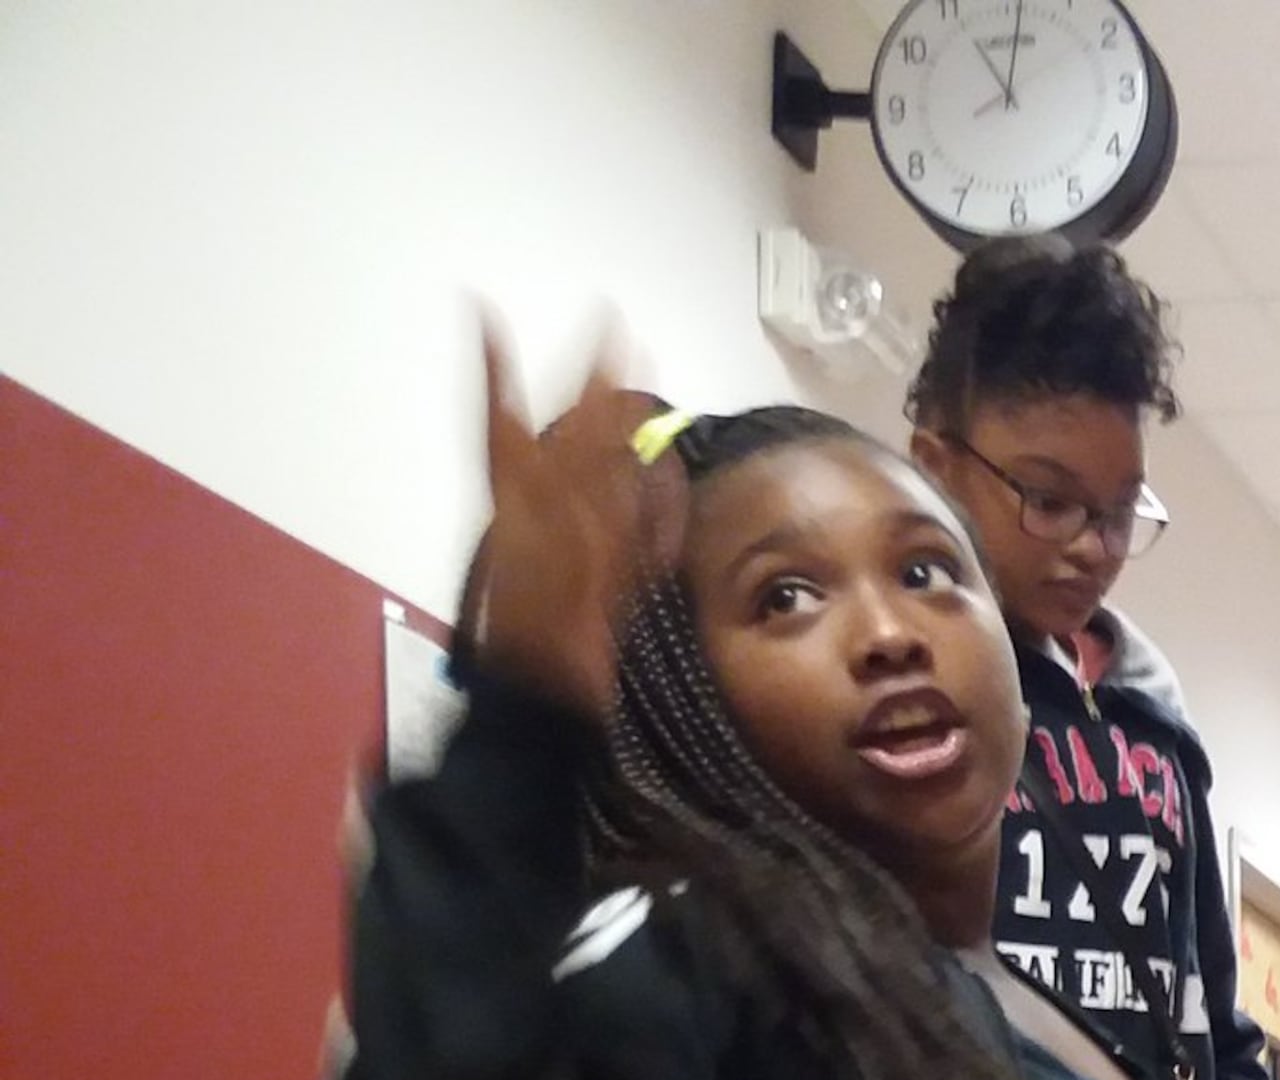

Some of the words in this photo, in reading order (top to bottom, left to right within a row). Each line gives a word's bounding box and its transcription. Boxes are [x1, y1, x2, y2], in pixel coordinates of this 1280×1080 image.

[1101, 17, 1117, 49] 2
[902, 35, 927, 65] 10
[1118, 72, 1135, 103] 3
[888, 95, 905, 125] 9
[1105, 132, 1121, 159] 4
[908, 150, 925, 181] 8
[952, 187, 973, 216] 7
[1066, 175, 1084, 206] 5
[1010, 196, 1027, 227] 6
